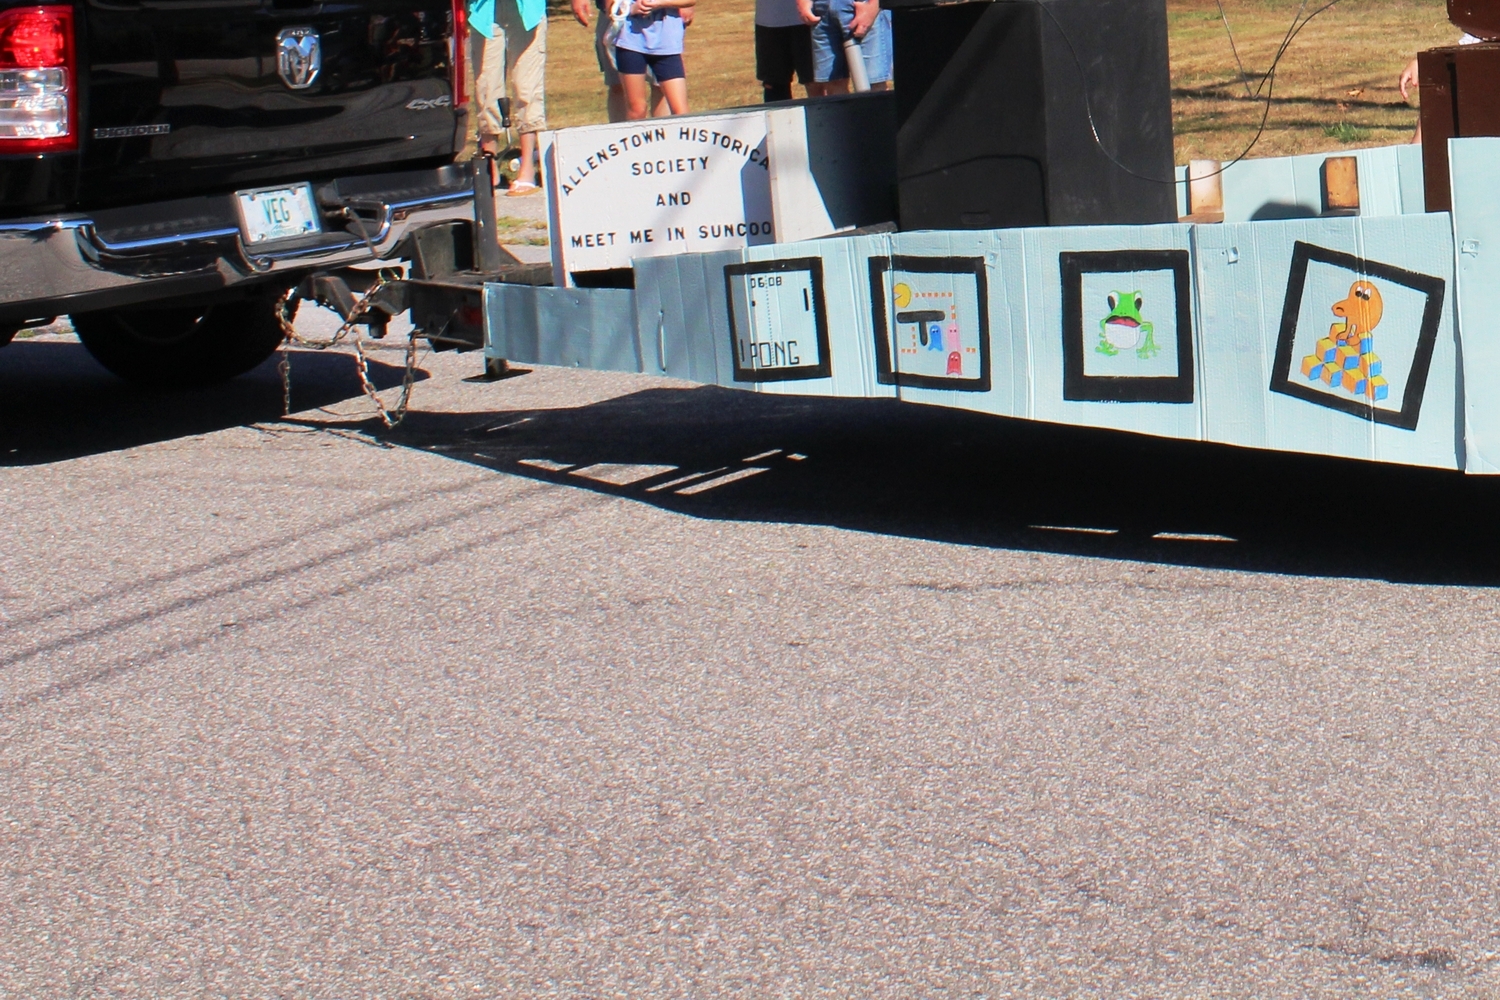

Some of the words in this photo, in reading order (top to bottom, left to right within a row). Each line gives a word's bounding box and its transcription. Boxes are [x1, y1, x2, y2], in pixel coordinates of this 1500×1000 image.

[561, 127, 666, 196] ALLENSTOWN
[679, 127, 770, 171] HISTORICA
[631, 156, 709, 176] SOCIETY
[262, 197, 291, 224] VEG
[656, 191, 692, 206] AND
[571, 232, 616, 248] MEET
[629, 228, 654, 243] ME
[667, 226, 686, 241] IN
[750, 341, 800, 368] PONG
